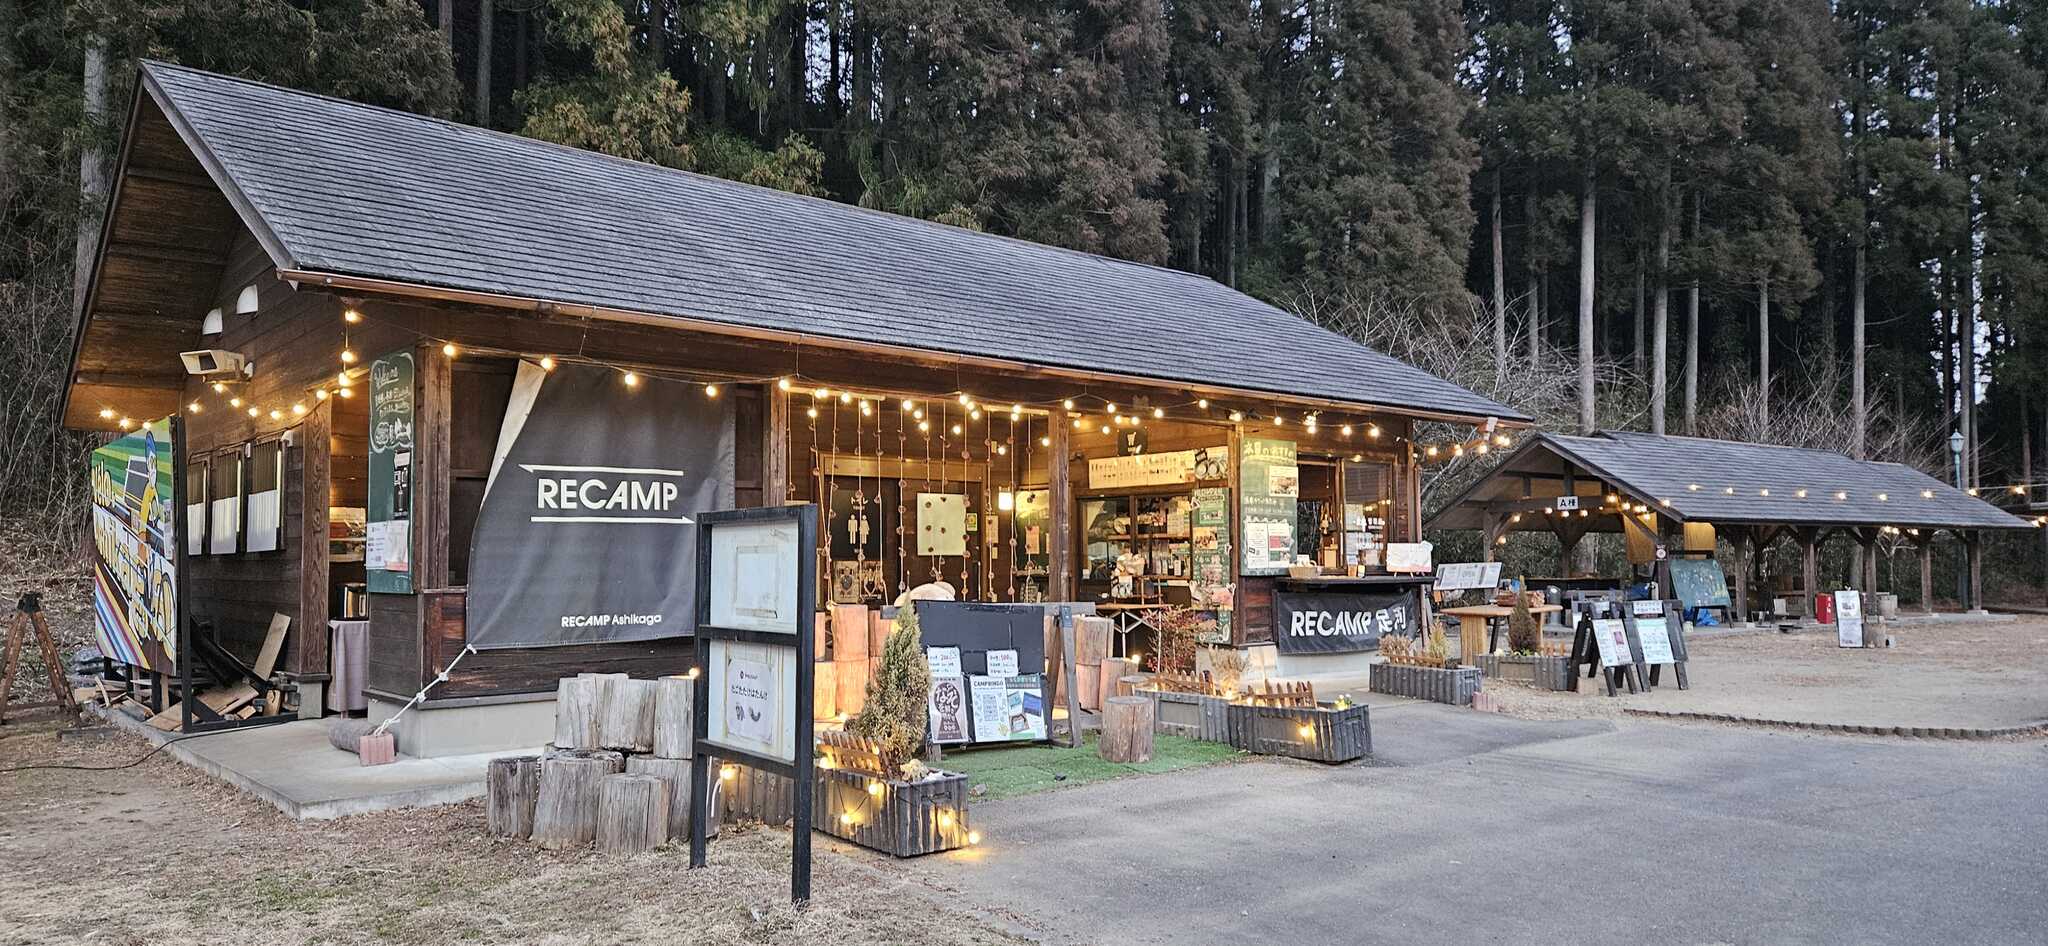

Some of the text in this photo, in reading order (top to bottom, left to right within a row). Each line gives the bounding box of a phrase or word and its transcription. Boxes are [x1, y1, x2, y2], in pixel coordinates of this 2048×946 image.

[537, 478, 678, 511] RECAMP
[561, 613, 662, 628] RECAMP Ashikaga
[1290, 606, 1406, 637] RECAMP 足利
